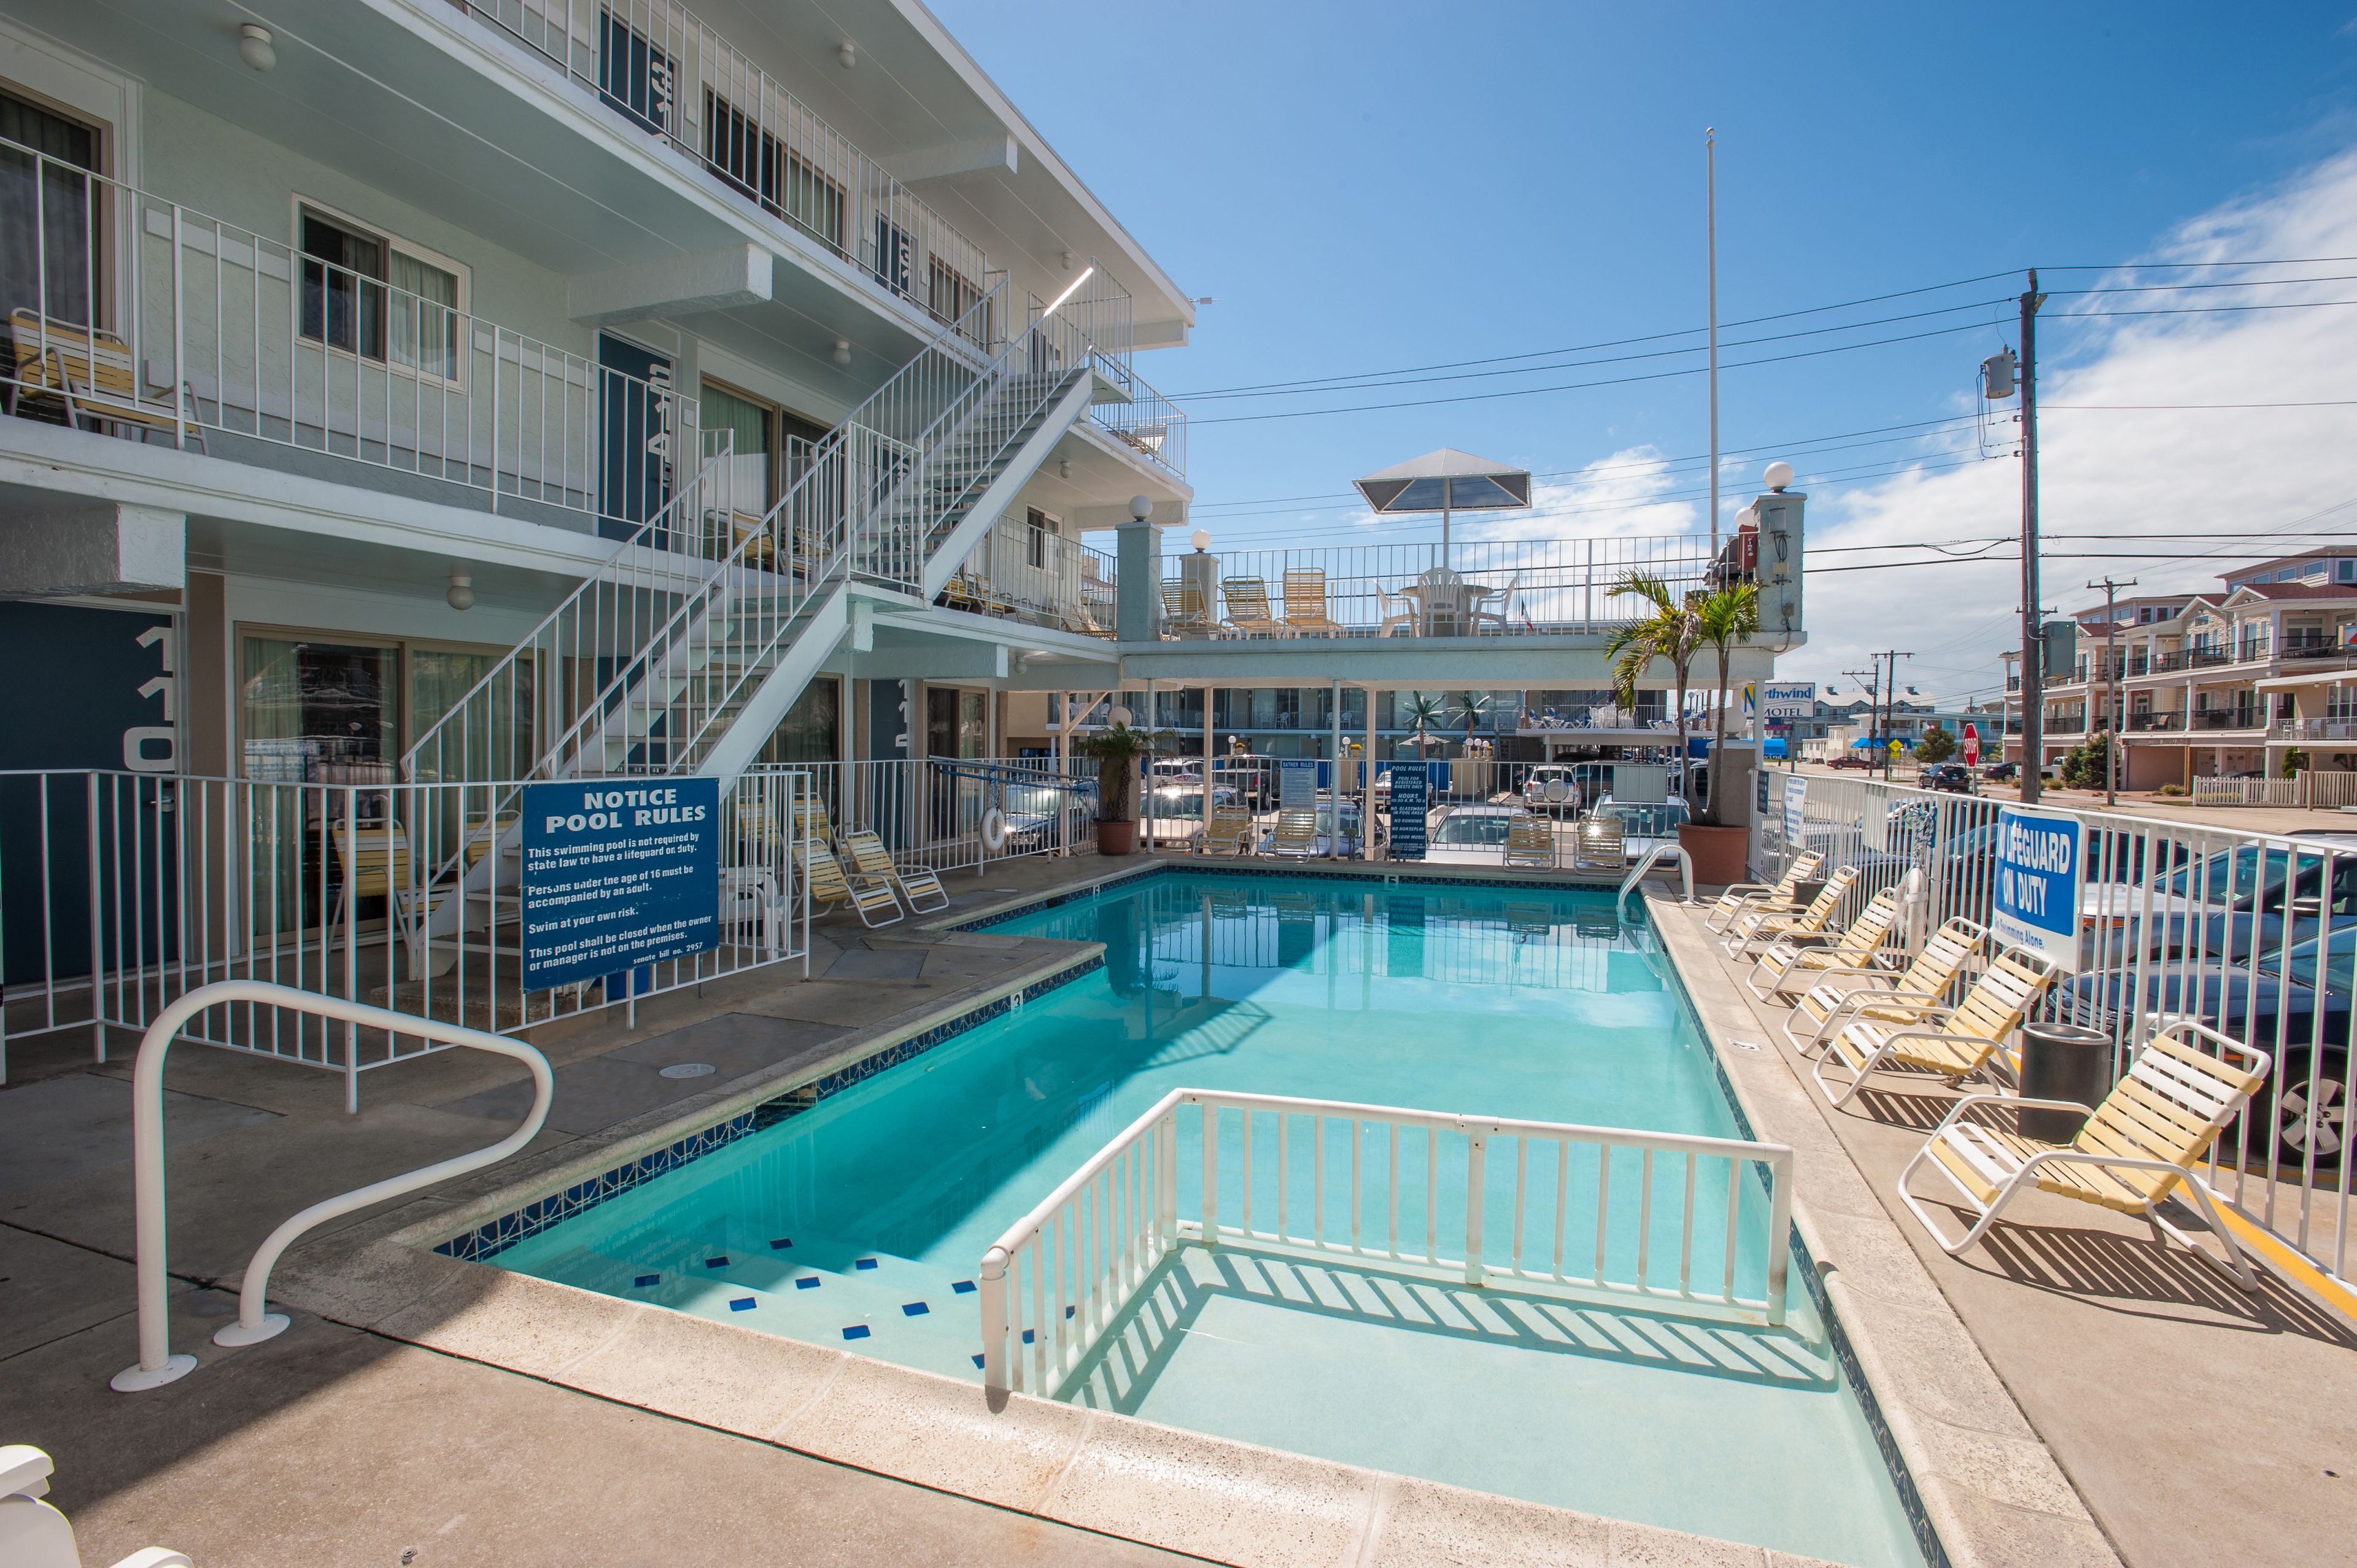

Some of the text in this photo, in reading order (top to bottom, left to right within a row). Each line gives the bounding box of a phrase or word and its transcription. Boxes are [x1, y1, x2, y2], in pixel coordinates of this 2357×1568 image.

[124, 626, 175, 771] 110
[1964, 738, 1977, 754] STOP
[584, 789, 676, 809] NOTICE
[546, 806, 705, 833] POOL RULES
[528, 832, 699, 858] This swimming pool is not required by
[528, 860, 557, 871] state
[559, 857, 578, 868] law
[579, 856, 590, 865] to
[592, 853, 615, 863] have
[624, 846, 664, 860] lifeguard
[678, 844, 697, 855] duty.
[2007, 825, 2071, 875] LIFEGUARD
[528, 882, 571, 896] Persons
[574, 878, 602, 890] under
[621, 875, 637, 884] age
[639, 870, 649, 880] of
[650, 869, 660, 878] 16
[662, 867, 682, 877] must
[683, 865, 694, 874] be
[2003, 867, 2047, 917] ON DUTY
[528, 882, 652, 909] accompanied by an adult.
[528, 906, 639, 935] Swim at your own risk.
[2000, 918, 2024, 944] Swimming
[529, 916, 711, 959] This pool shall be closed when the owner
[529, 931, 687, 971] or manager is not on the premises.
[633, 953, 656, 964] senate
[659, 949, 670, 959] bill
[686, 941, 703, 952] 2957
